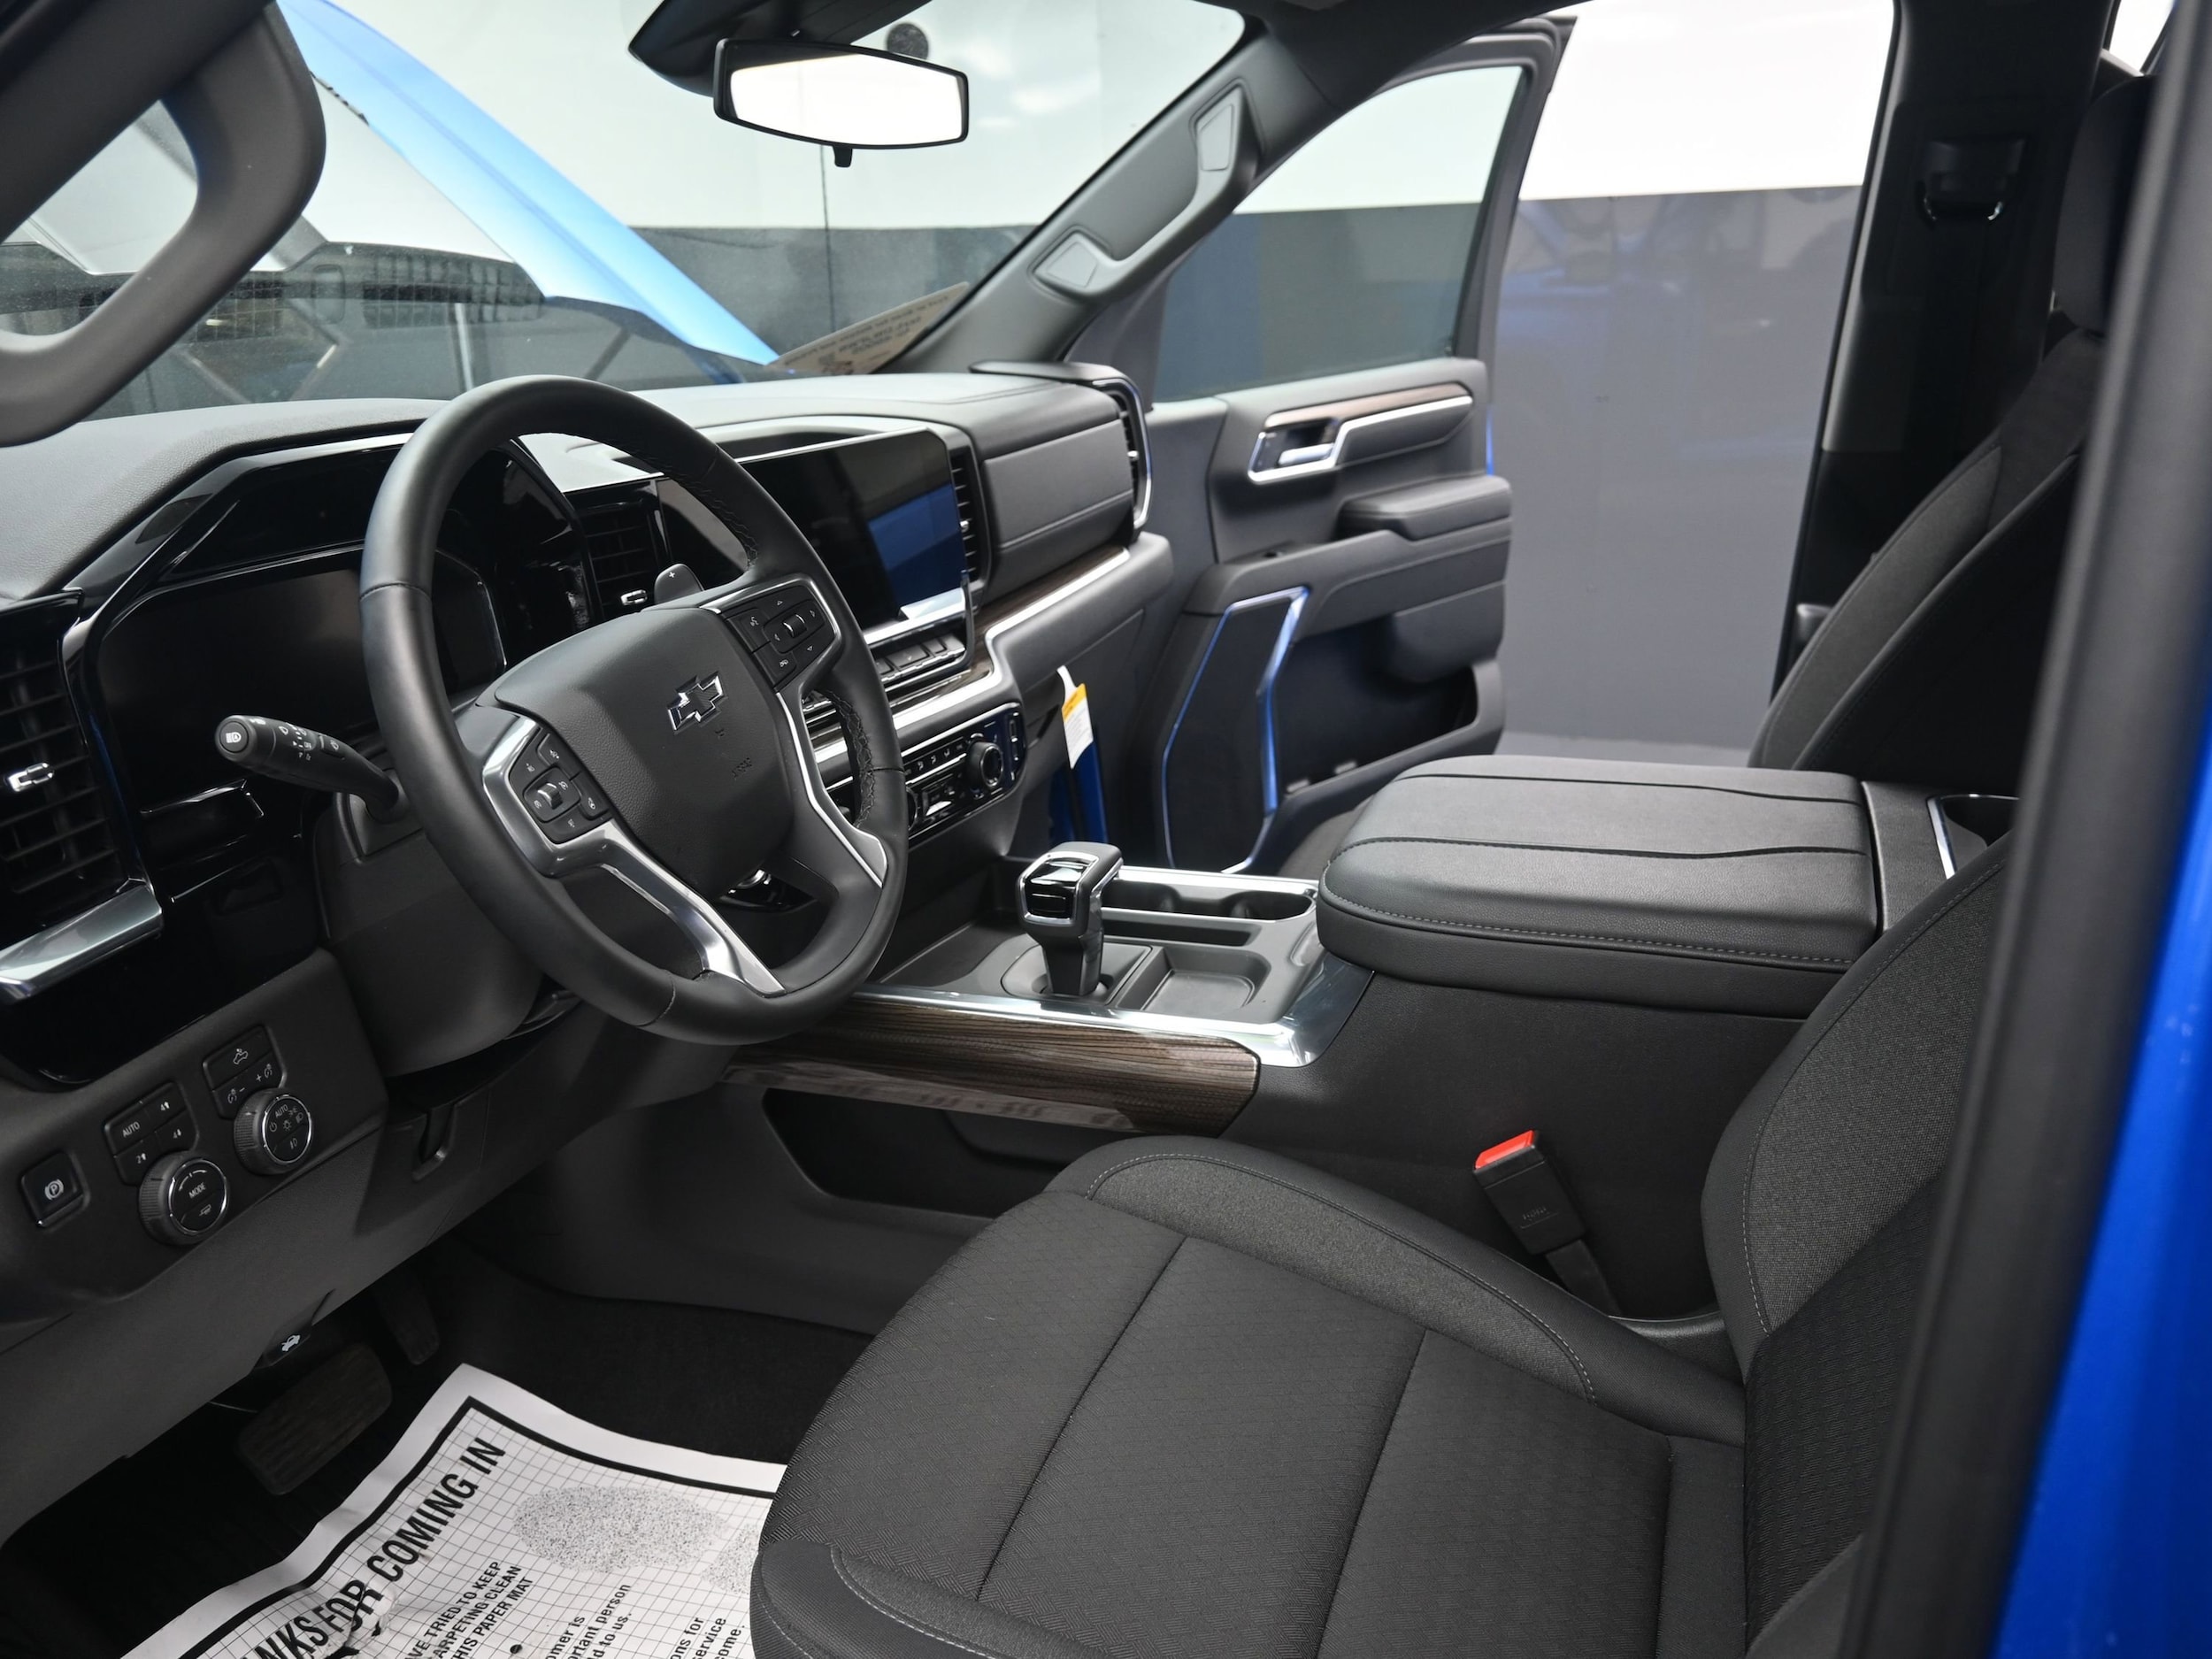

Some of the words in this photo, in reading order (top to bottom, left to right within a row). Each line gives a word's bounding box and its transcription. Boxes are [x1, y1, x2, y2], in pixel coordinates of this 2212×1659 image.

[275, 1104, 288, 1118] AUTO
[122, 1120, 141, 1138] AUTO
[188, 1182, 206, 1198] MODE
[311, 1579, 384, 1632] FOR
[366, 1473, 479, 1582] COMING
[459, 1437, 506, 1475] IN
[424, 1606, 462, 1638] TRIED
[457, 1591, 477, 1605] TO
[472, 1561, 502, 1590] KEEP
[427, 1601, 490, 1659] ARPETING
[485, 1565, 522, 1600] CLEAN
[595, 1584, 631, 1624] person
[450, 1638, 478, 1659] HIS
[472, 1601, 512, 1636] PAPER
[506, 1576, 533, 1601] MAT
[568, 1616, 586, 1627] is
[598, 1633, 616, 1646] to
[611, 1613, 632, 1630] us.
[683, 1617, 704, 1635] for
